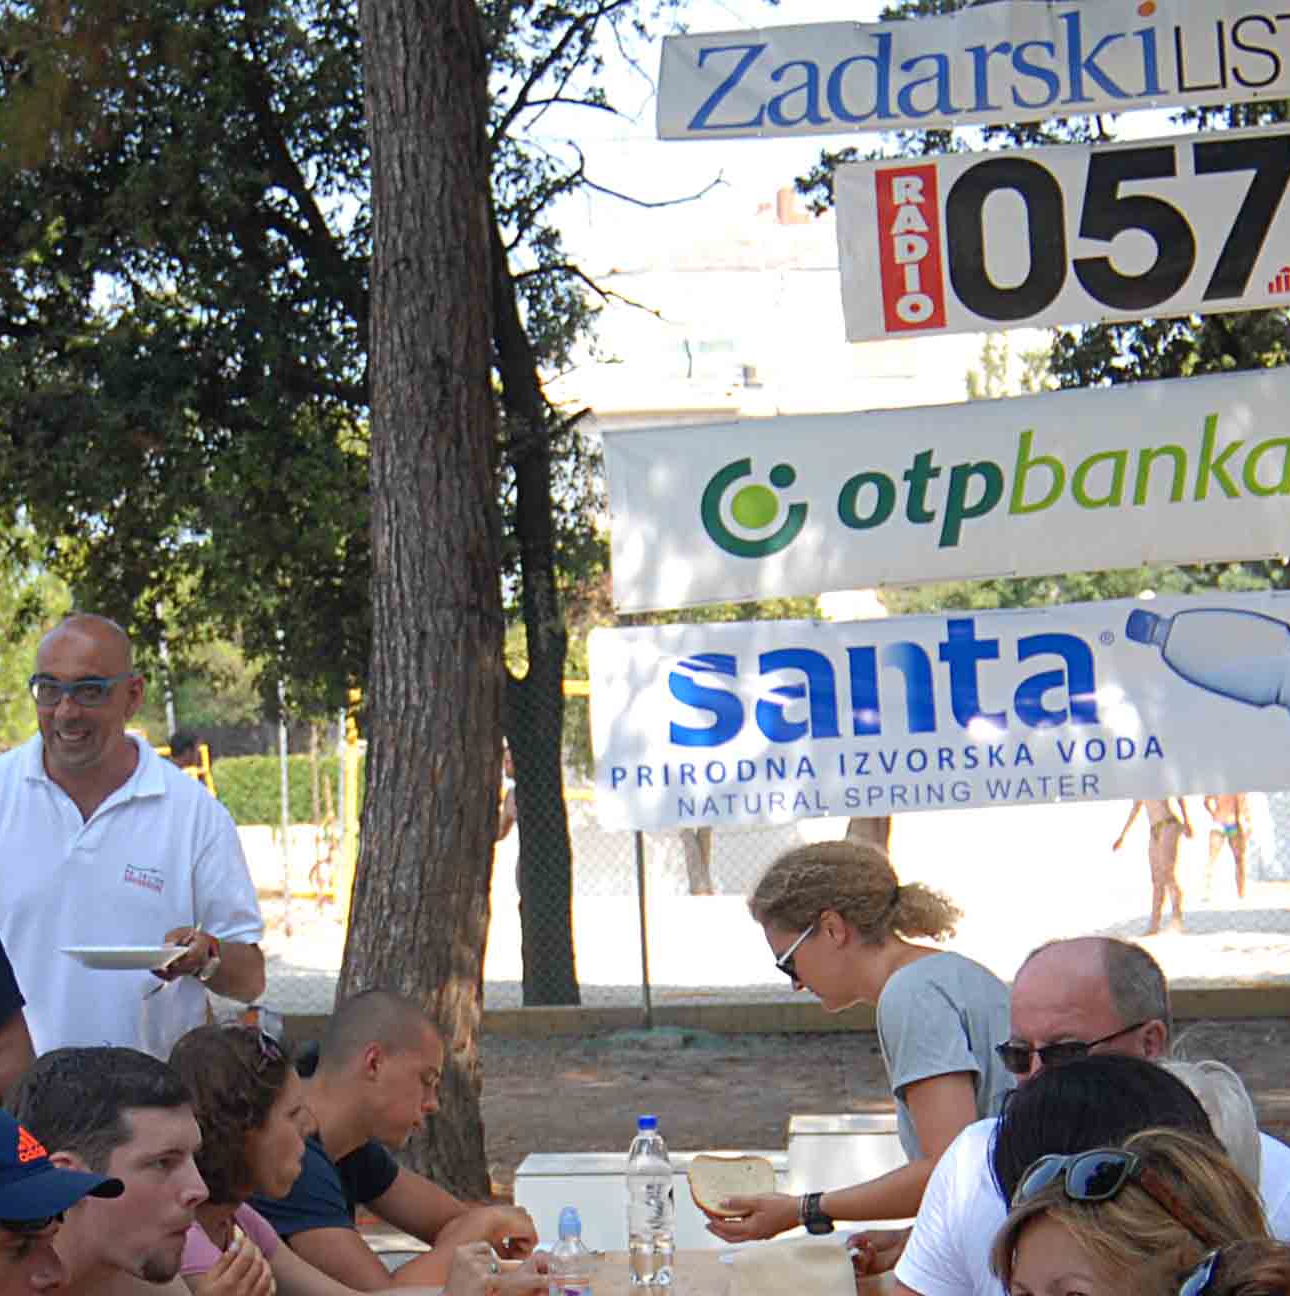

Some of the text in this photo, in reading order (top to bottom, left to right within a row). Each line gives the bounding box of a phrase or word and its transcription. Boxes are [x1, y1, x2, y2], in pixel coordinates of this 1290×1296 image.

[890, 175, 936, 324] RADIO
[667, 618, 1101, 748] santa
[611, 735, 1165, 789] PRIRODNA IZVORSKA VODA
[677, 772, 1100, 817] NATURAL SPRING WATER
